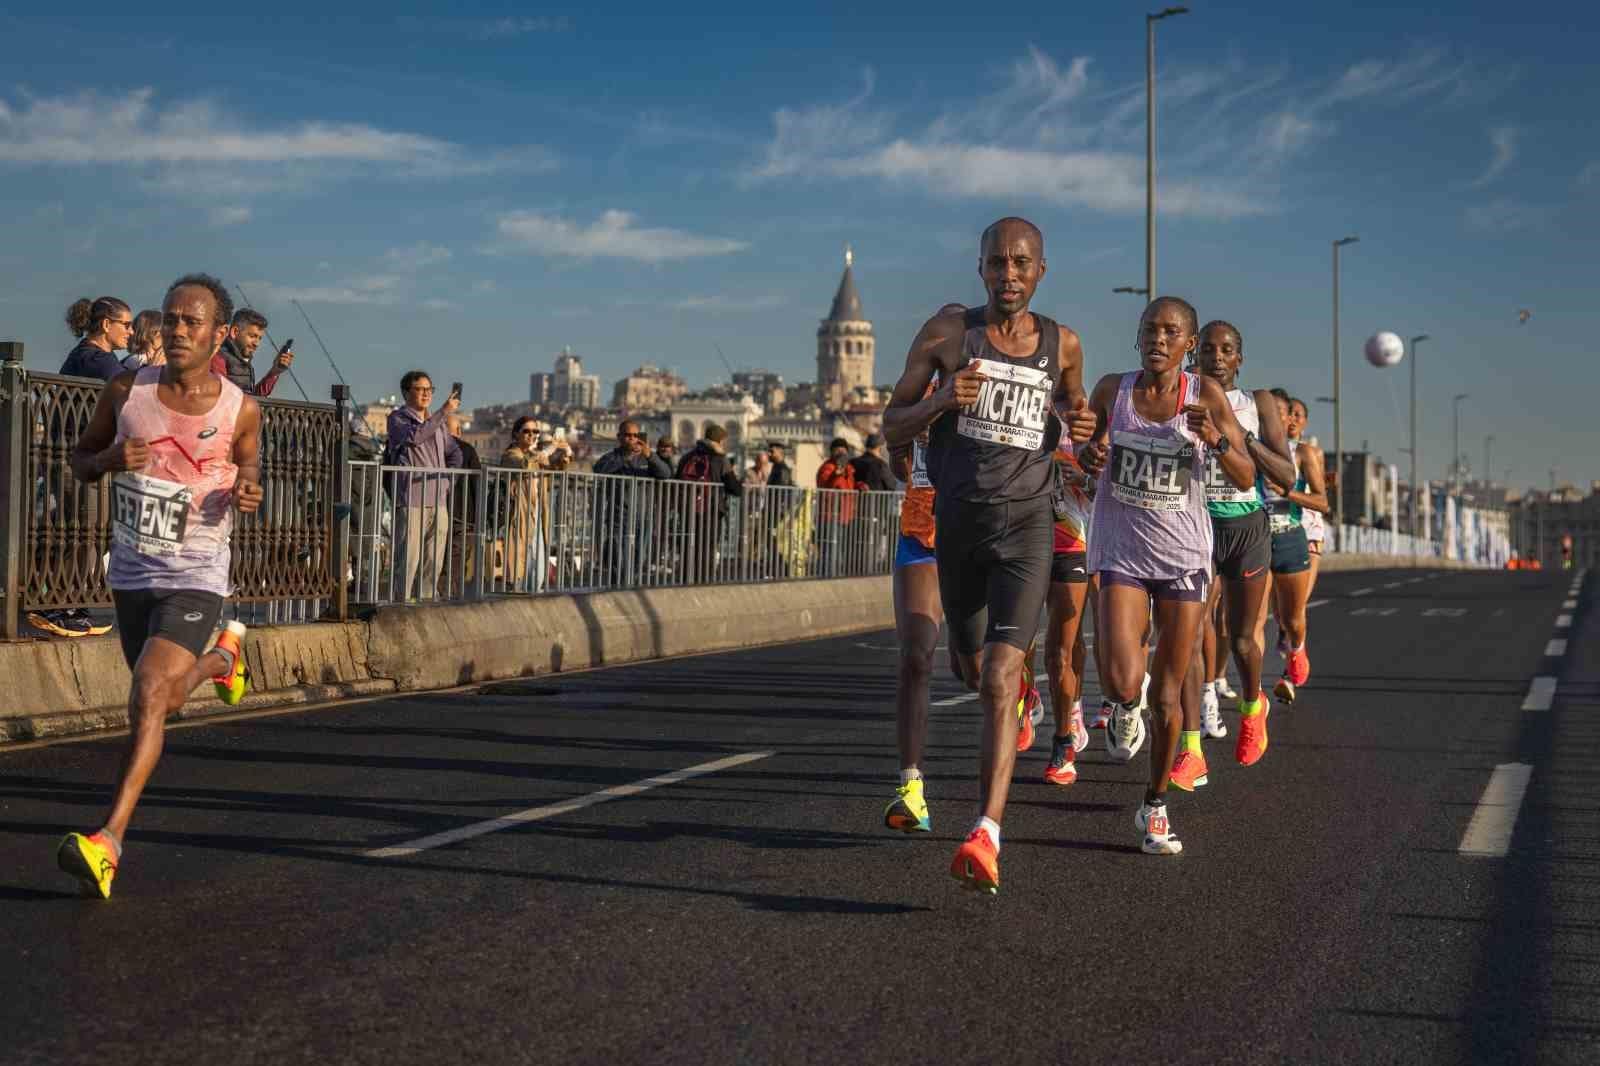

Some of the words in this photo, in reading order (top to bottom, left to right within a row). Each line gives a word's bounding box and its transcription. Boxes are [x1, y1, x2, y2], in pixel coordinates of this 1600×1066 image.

[1000, 426, 1039, 441] MARATHON
[1119, 448, 1181, 493] RAEL
[115, 485, 183, 540] FETENE
